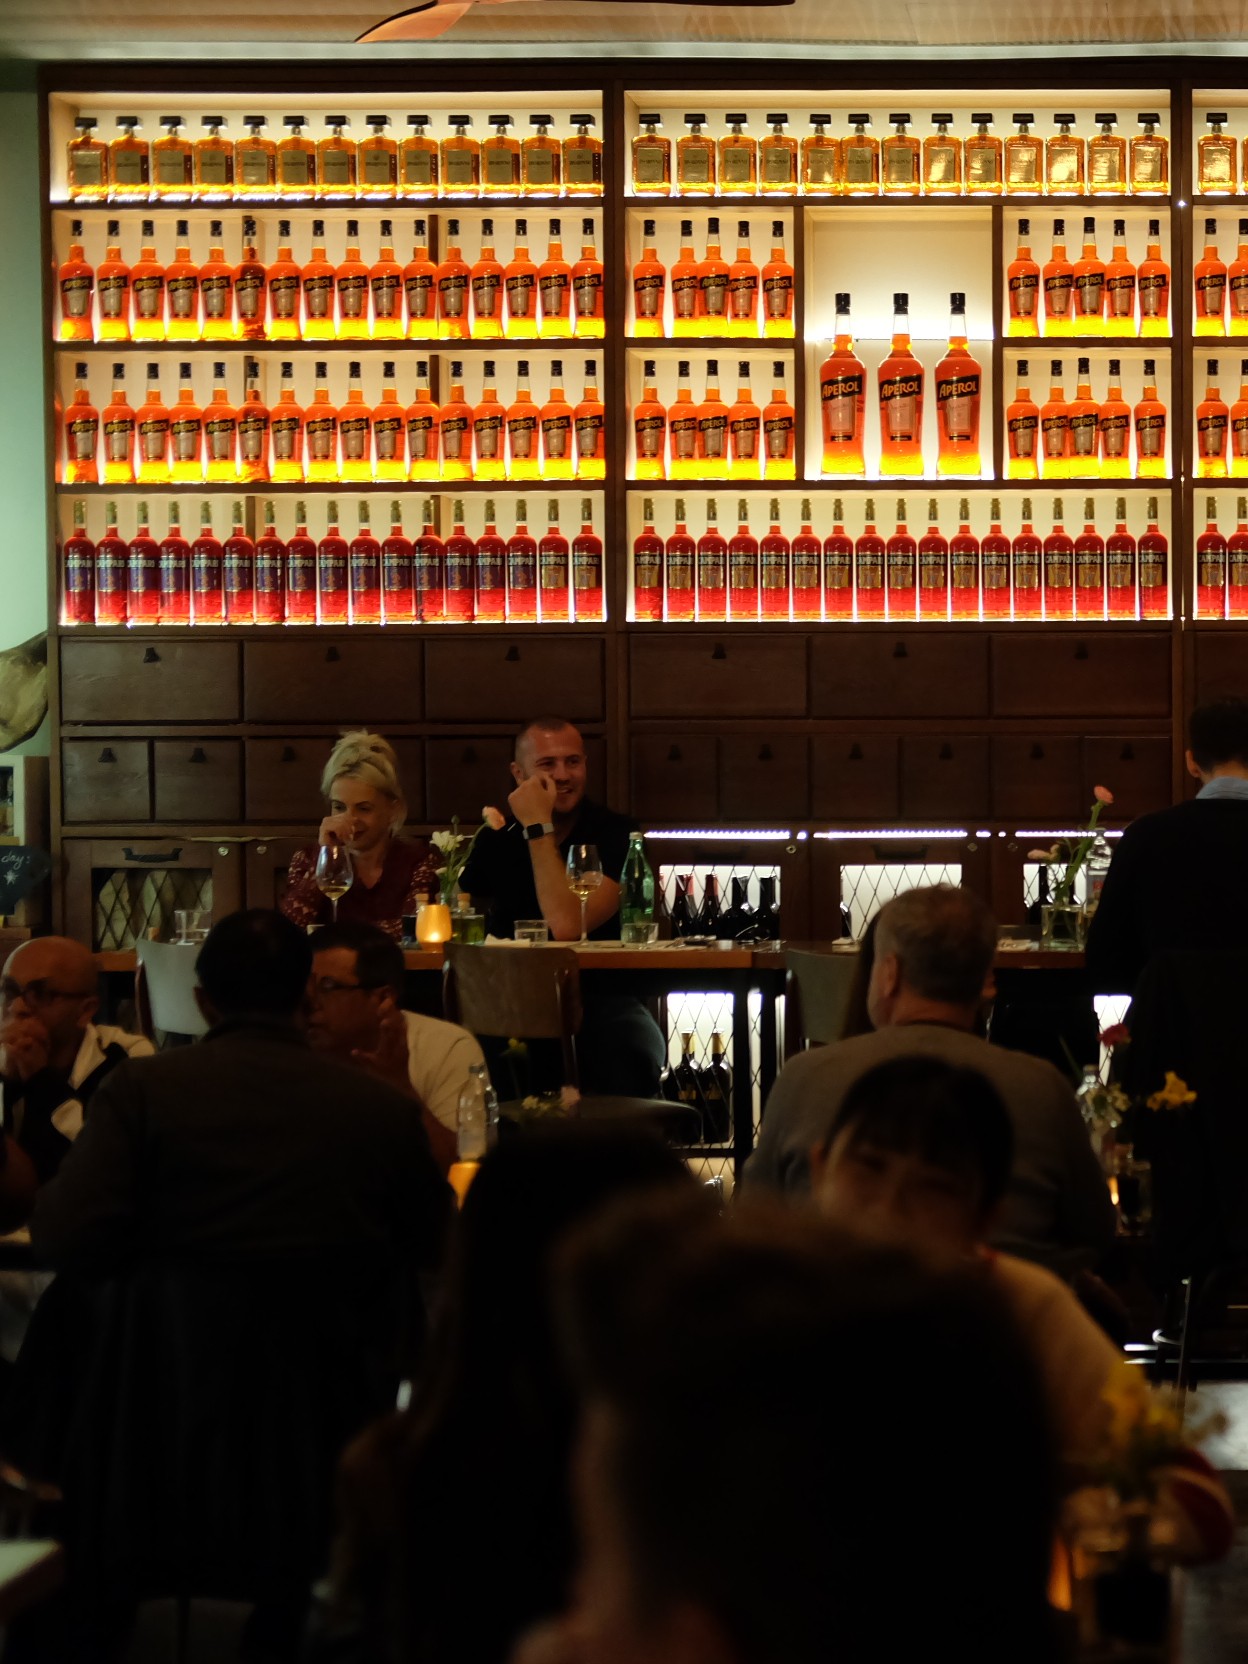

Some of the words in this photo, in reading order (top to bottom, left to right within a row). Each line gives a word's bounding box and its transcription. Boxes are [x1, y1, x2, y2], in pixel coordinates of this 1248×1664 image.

[822, 382, 859, 398] APEROL
[881, 382, 919, 398] APEROL
[940, 382, 977, 398] APEROL
